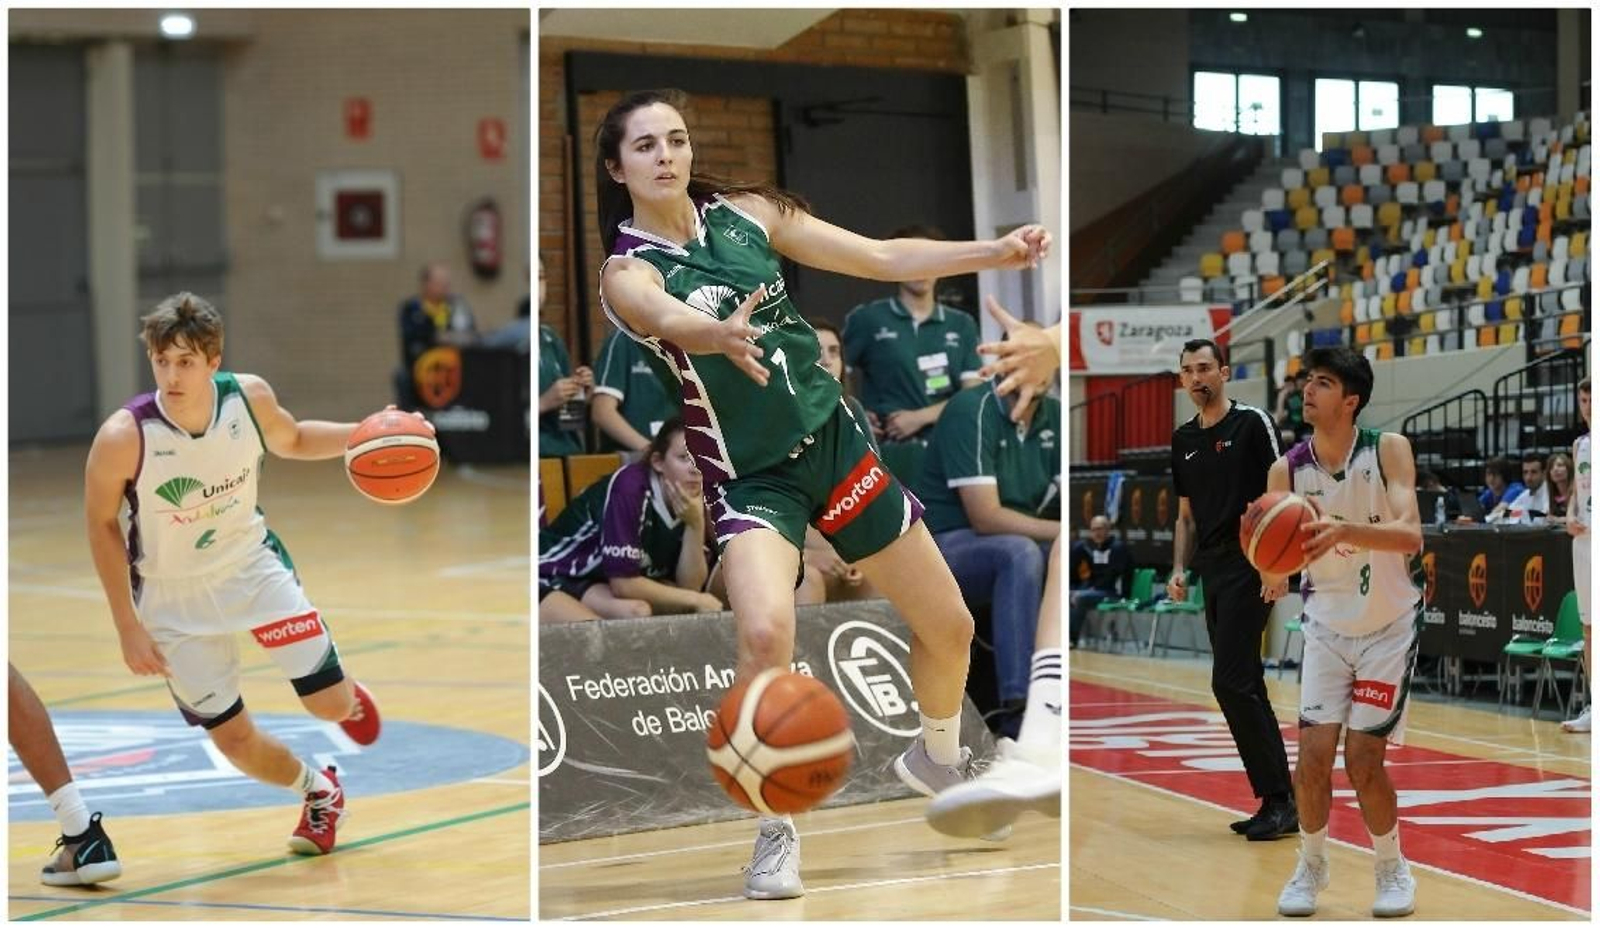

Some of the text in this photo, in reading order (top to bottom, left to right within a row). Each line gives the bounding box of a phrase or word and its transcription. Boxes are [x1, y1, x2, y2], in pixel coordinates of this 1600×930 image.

[1119, 322, 1193, 343] Zaragoza
[822, 466, 884, 521] worten
[194, 528, 217, 550] 6
[1359, 563, 1371, 596] 8
[258, 619, 317, 643] worten
[565, 667, 699, 701] Federación
[631, 709, 663, 737] de
